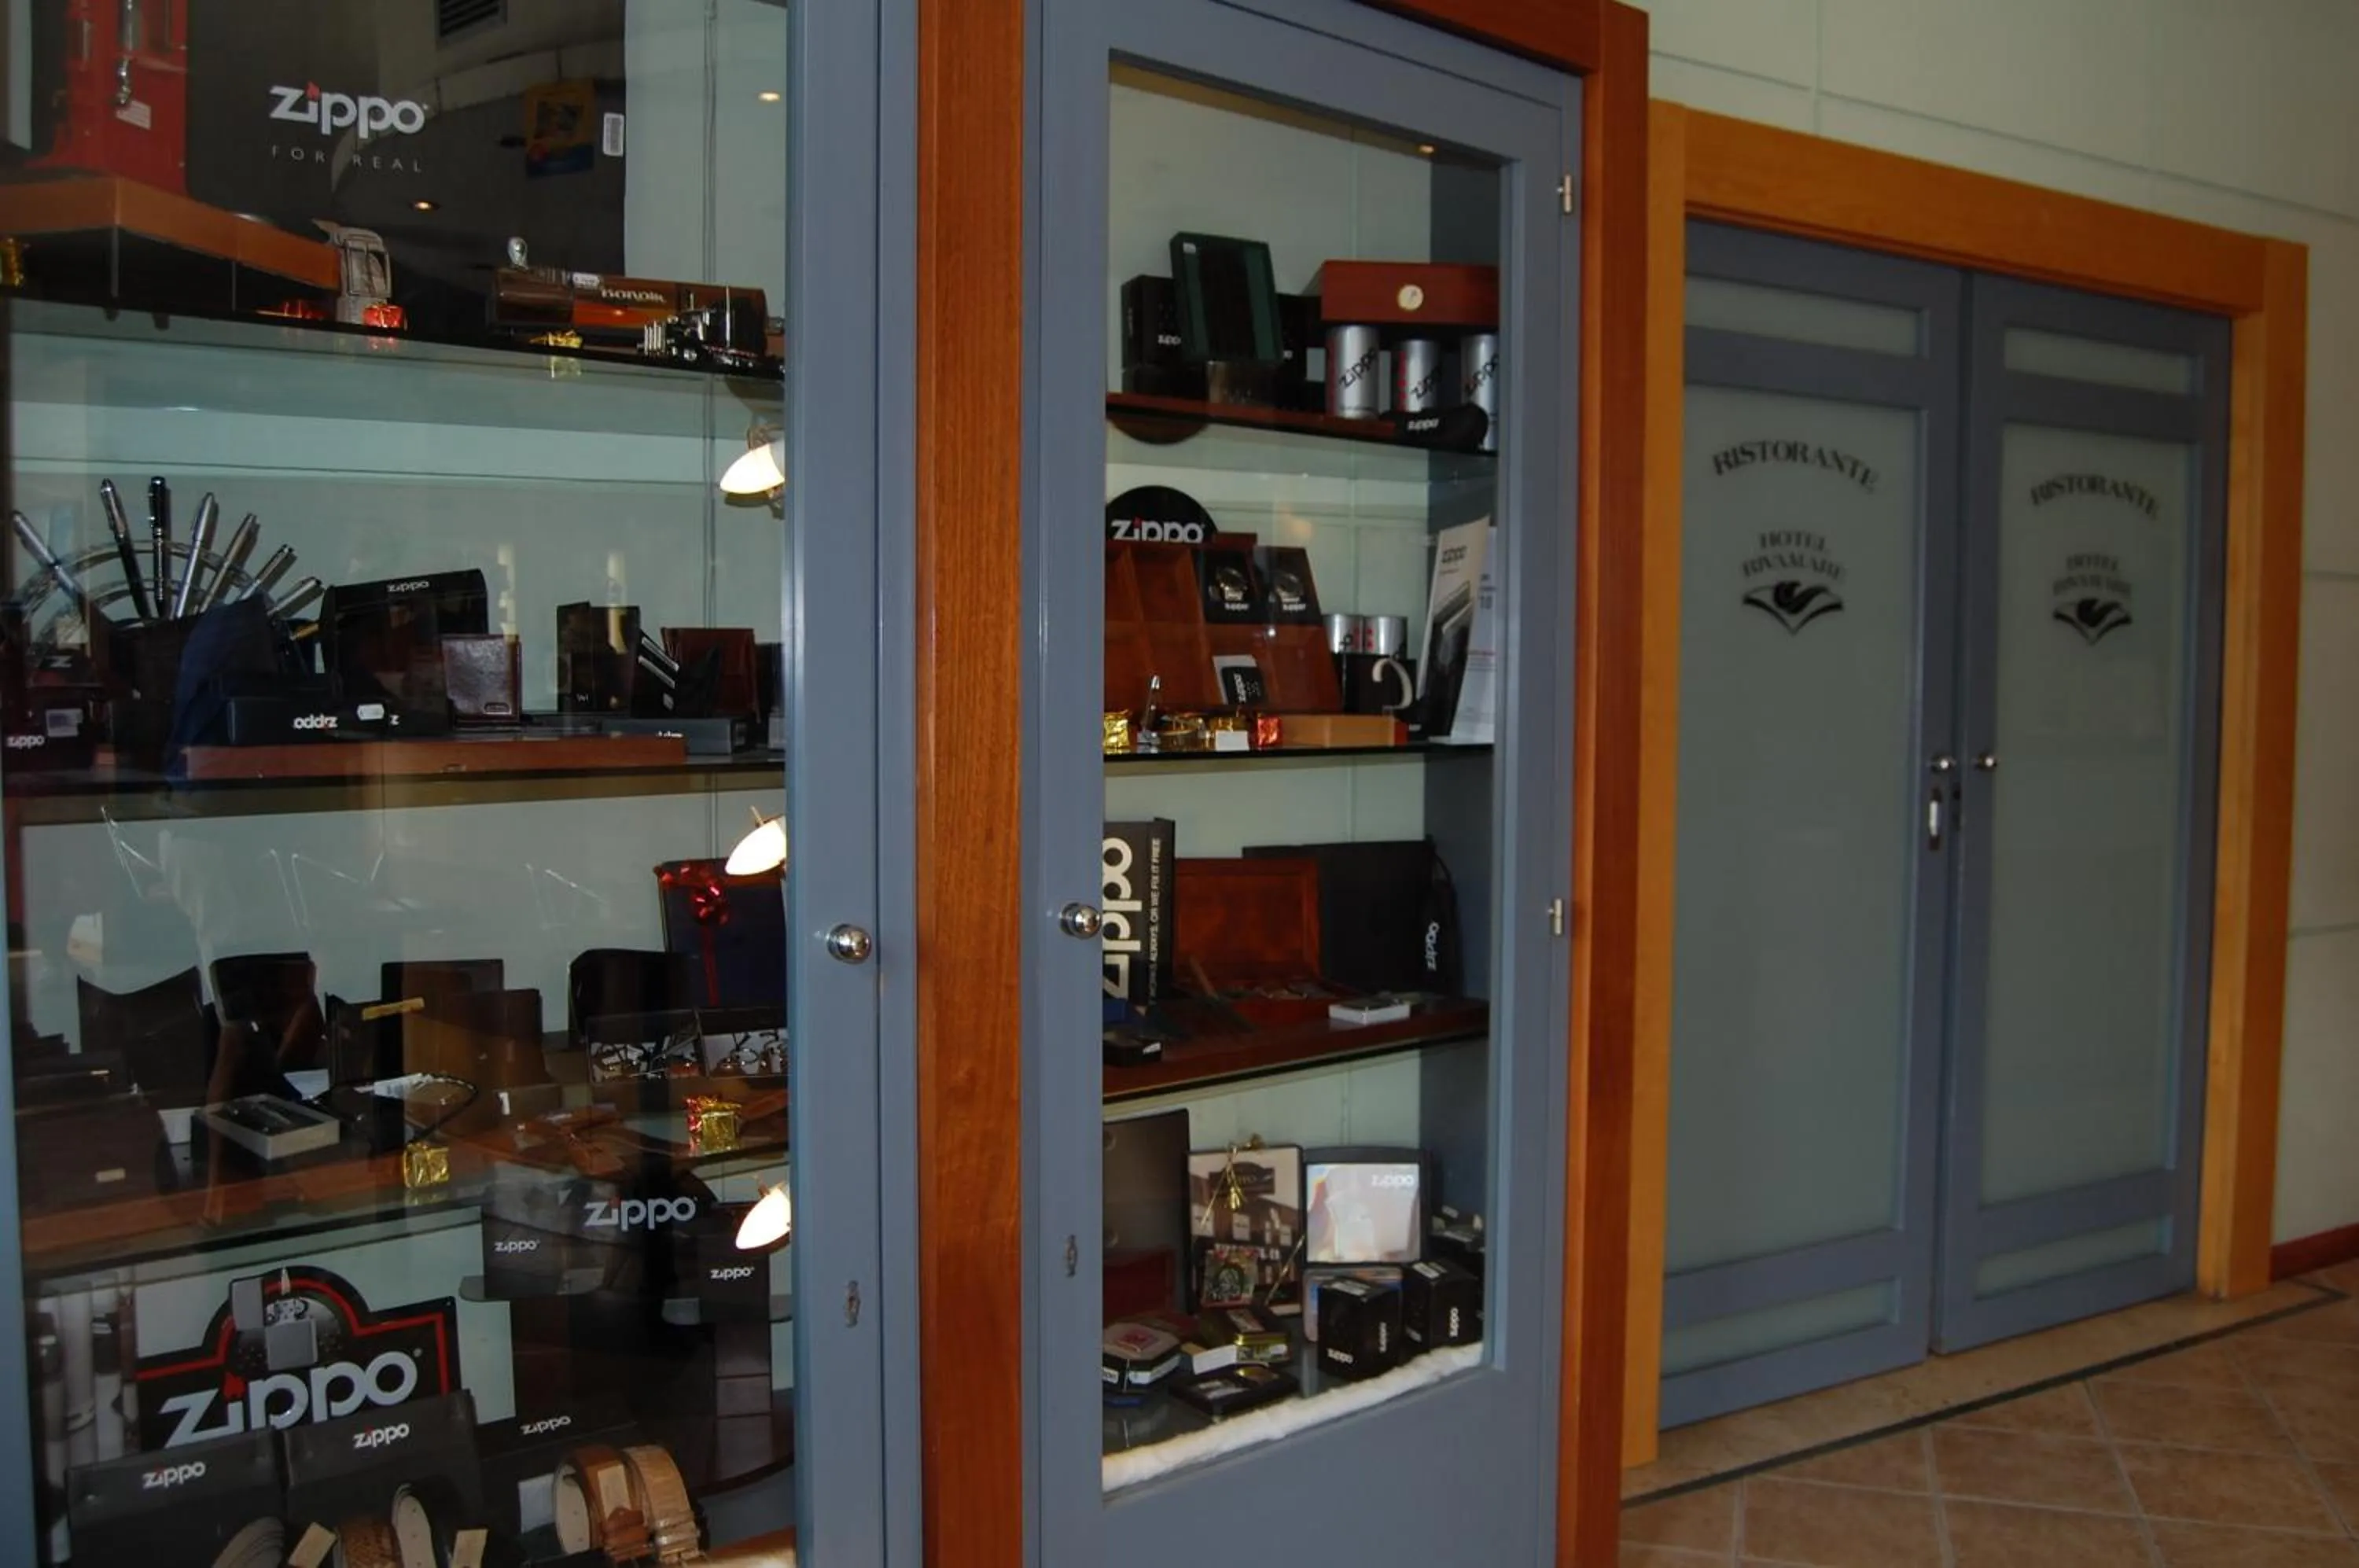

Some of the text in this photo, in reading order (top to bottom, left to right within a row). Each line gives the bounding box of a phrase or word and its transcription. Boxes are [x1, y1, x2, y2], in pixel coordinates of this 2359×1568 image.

[271, 144, 422, 173] FOR REAL
[1713, 440, 1879, 495] RISTORANTE
[2030, 473, 2159, 521] RISTORANTE
